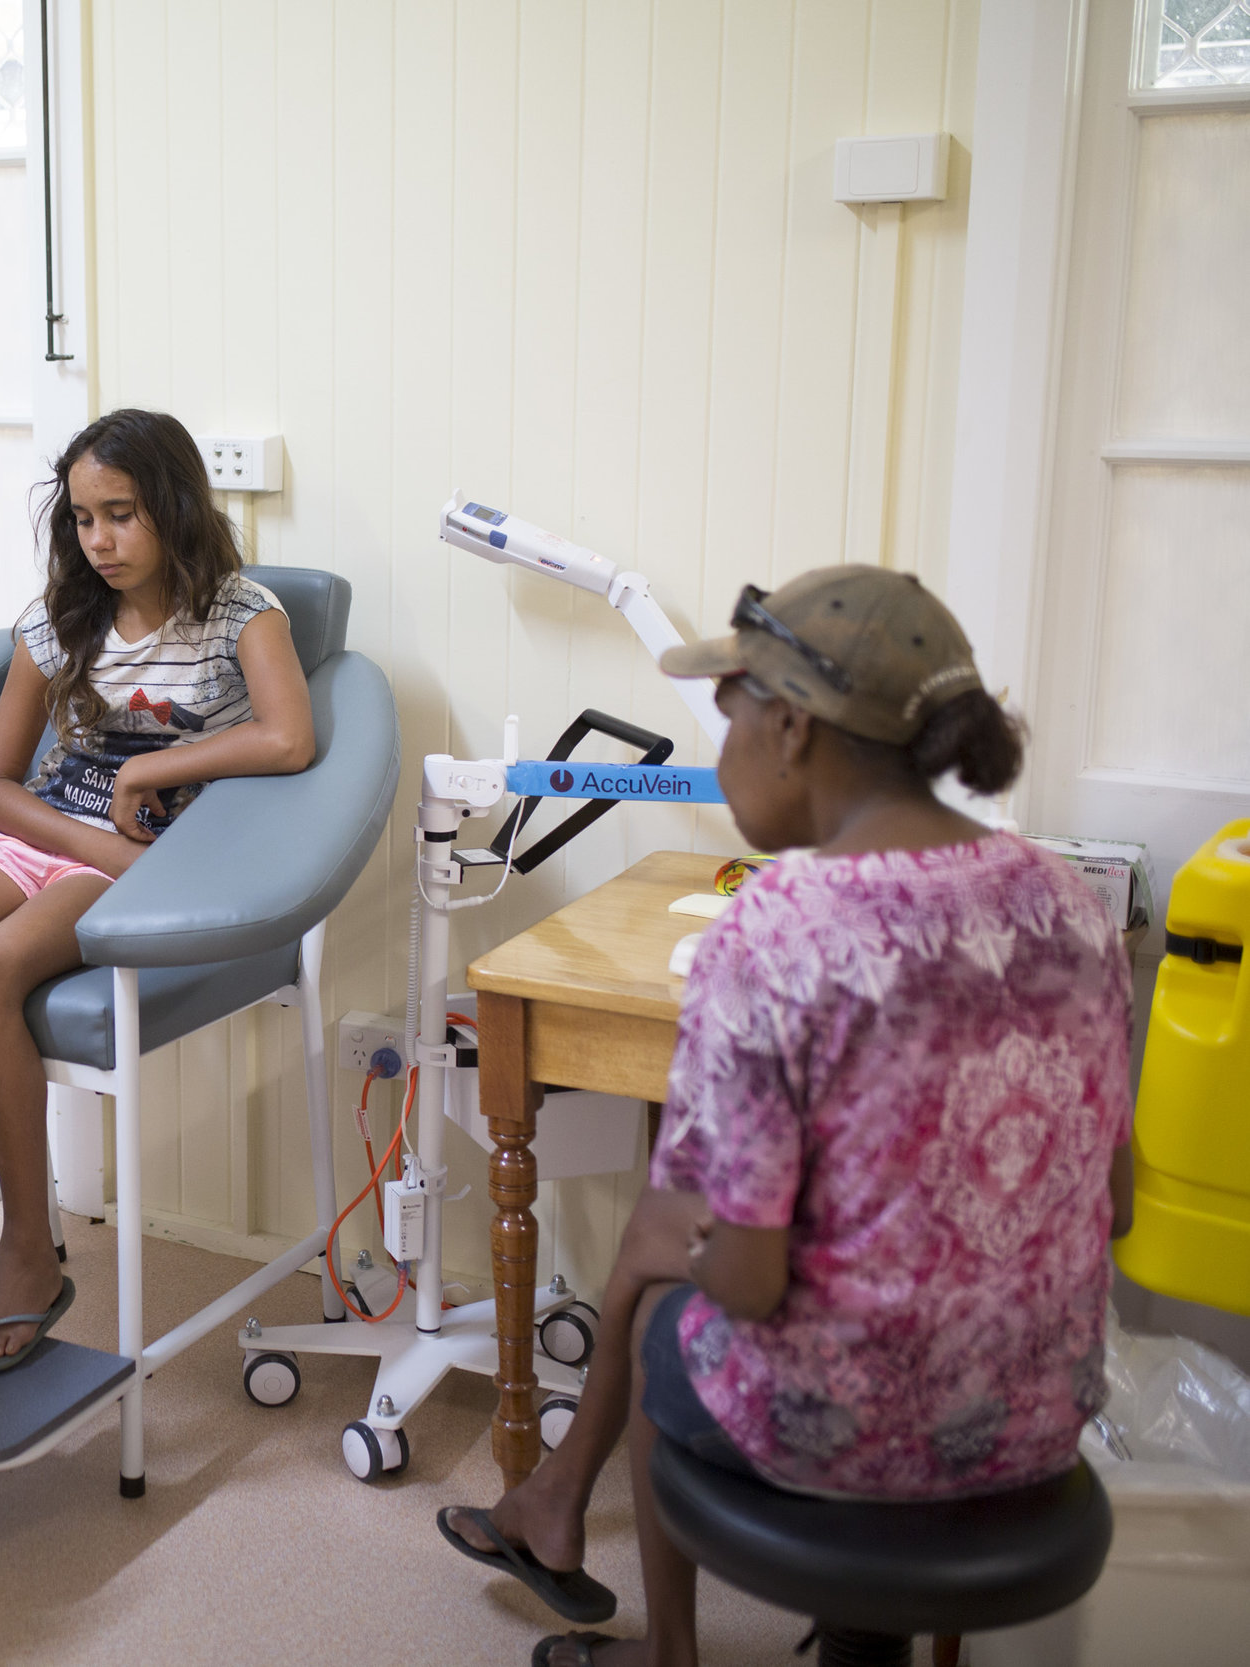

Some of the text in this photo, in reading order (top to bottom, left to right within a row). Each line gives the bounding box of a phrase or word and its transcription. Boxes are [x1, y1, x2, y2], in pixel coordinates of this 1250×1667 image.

[82, 768, 115, 792] SANT
[581, 772, 691, 796] AccuVein
[64, 783, 112, 814] NAUGHT
[1083, 865, 1127, 878] MEDIflex
